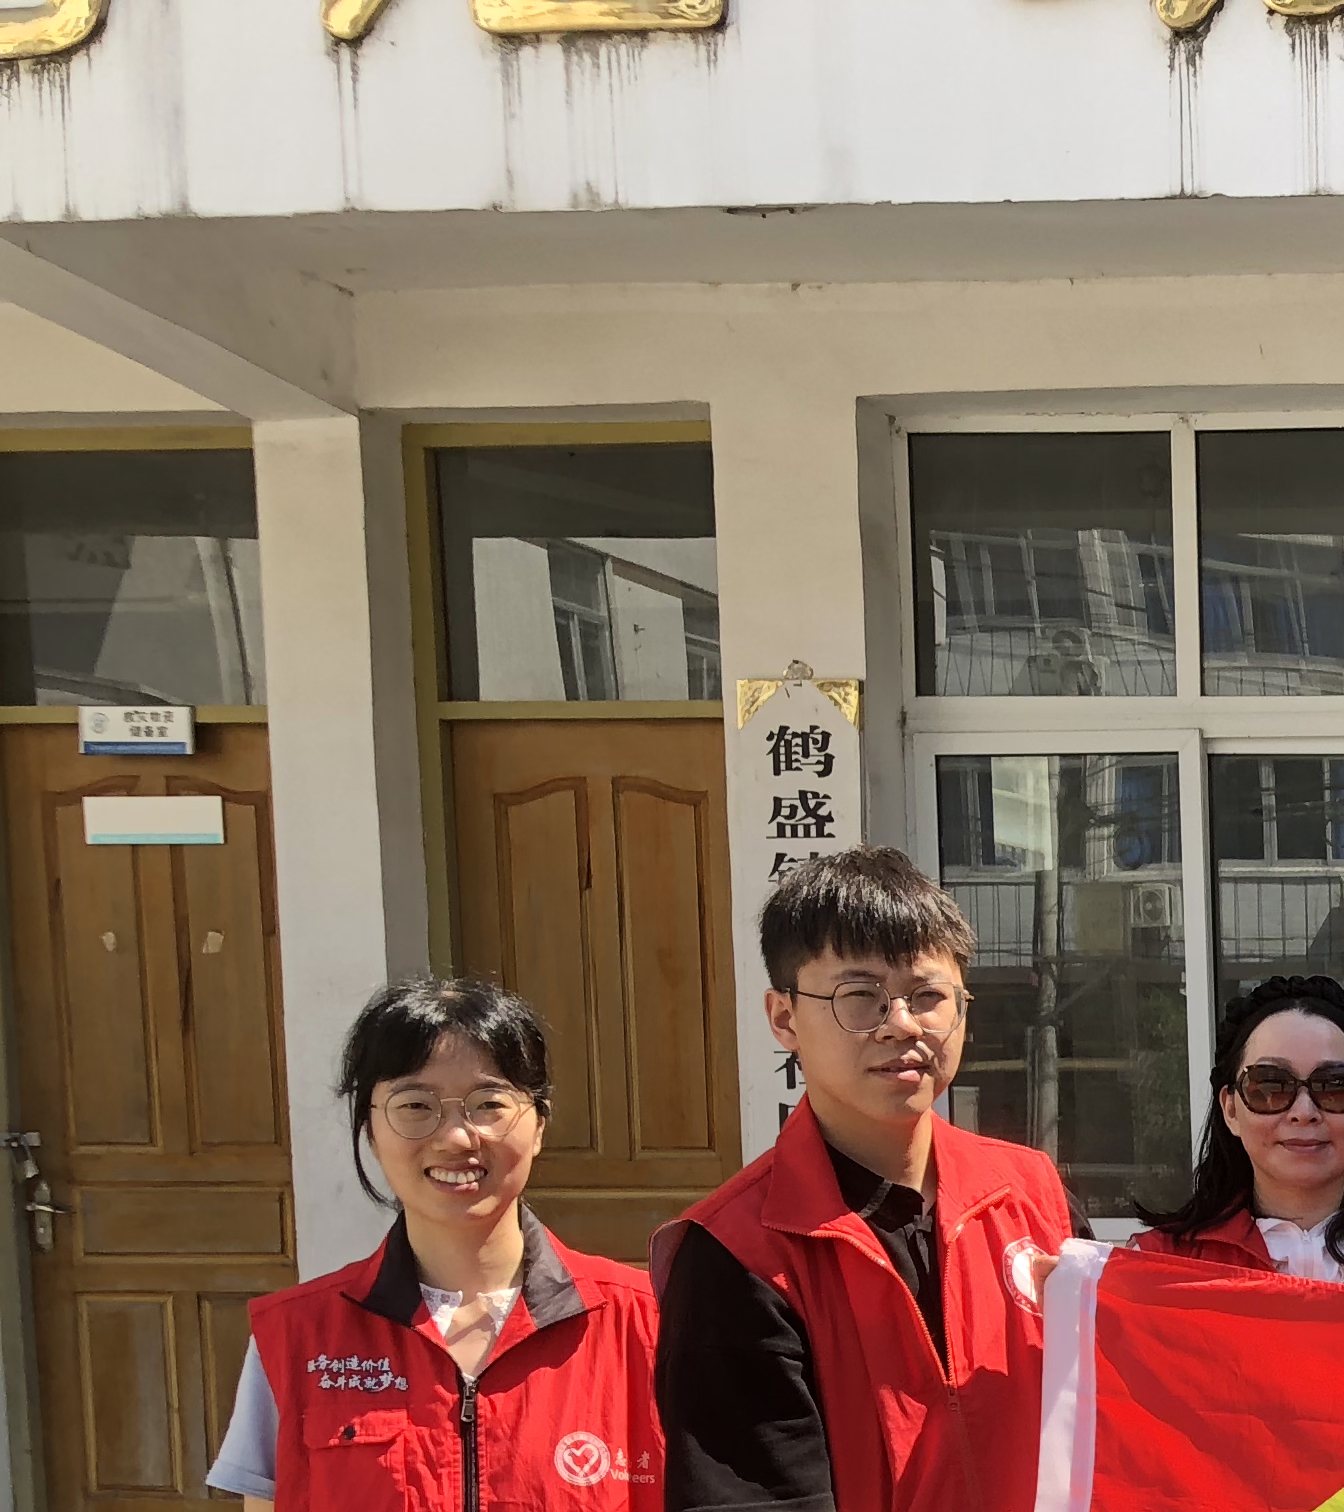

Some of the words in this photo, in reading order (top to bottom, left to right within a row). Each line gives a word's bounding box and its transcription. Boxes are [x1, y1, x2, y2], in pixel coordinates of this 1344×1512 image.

[317, 1371, 409, 1393] 奋斗成就梦想
